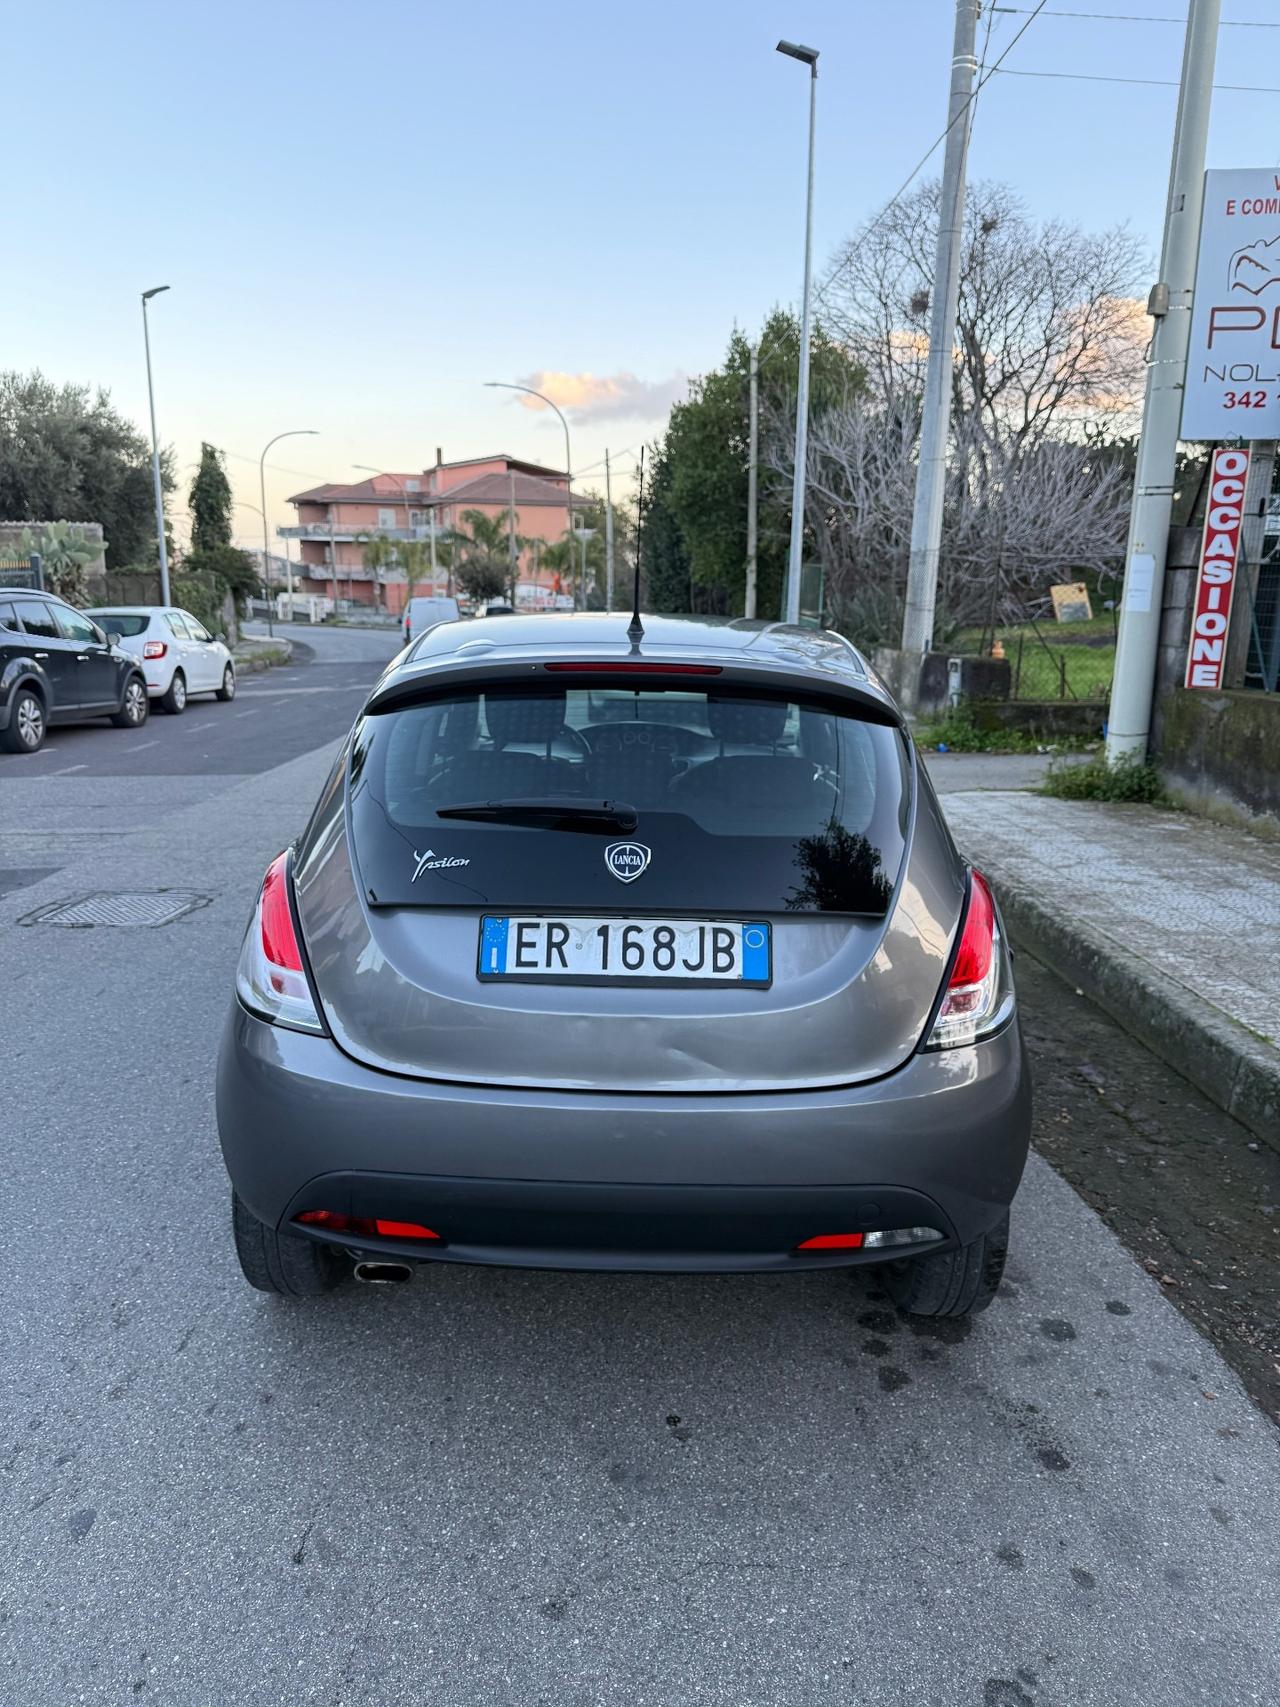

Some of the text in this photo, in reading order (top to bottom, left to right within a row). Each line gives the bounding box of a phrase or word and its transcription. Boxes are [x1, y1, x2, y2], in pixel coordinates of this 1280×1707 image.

[1226, 198, 1280, 216] E COM
[1207, 305, 1280, 350] P
[1203, 363, 1280, 383] NOL
[1222, 390, 1267, 409] 342
[1191, 451, 1249, 687] OCCASIONE
[411, 849, 470, 882] Ypsilon
[614, 854, 641, 866] LANCIA
[515, 922, 570, 968] ER
